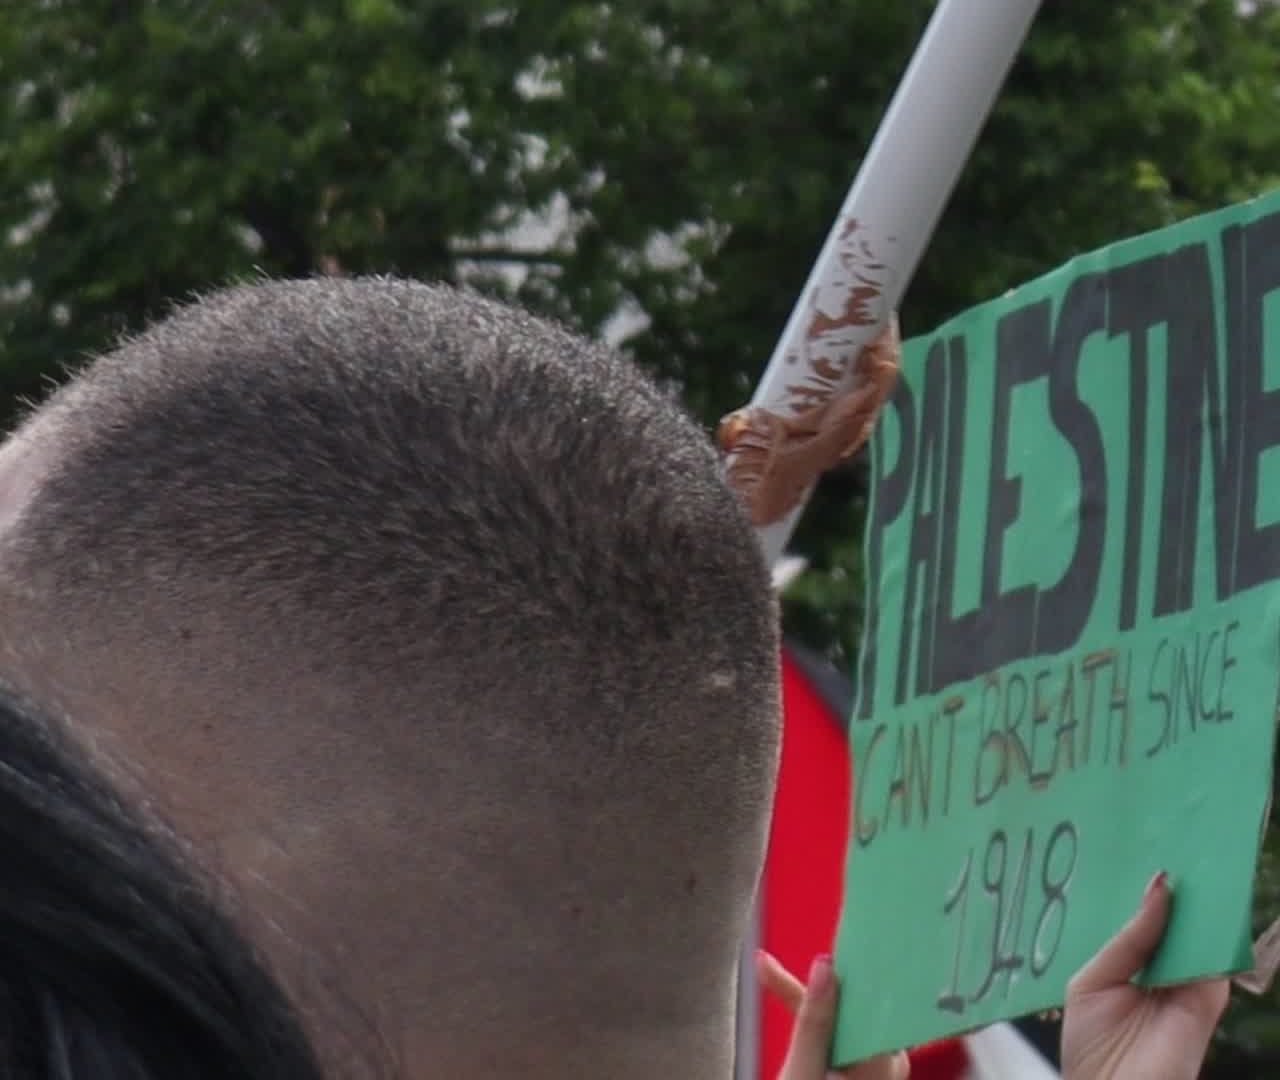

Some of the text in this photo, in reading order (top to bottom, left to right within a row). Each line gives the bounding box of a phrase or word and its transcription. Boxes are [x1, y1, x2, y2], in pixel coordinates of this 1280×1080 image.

[974, 648, 1133, 808] BREATH
[1143, 619, 1241, 760] SINCE
[936, 820, 1079, 1016] 1948
